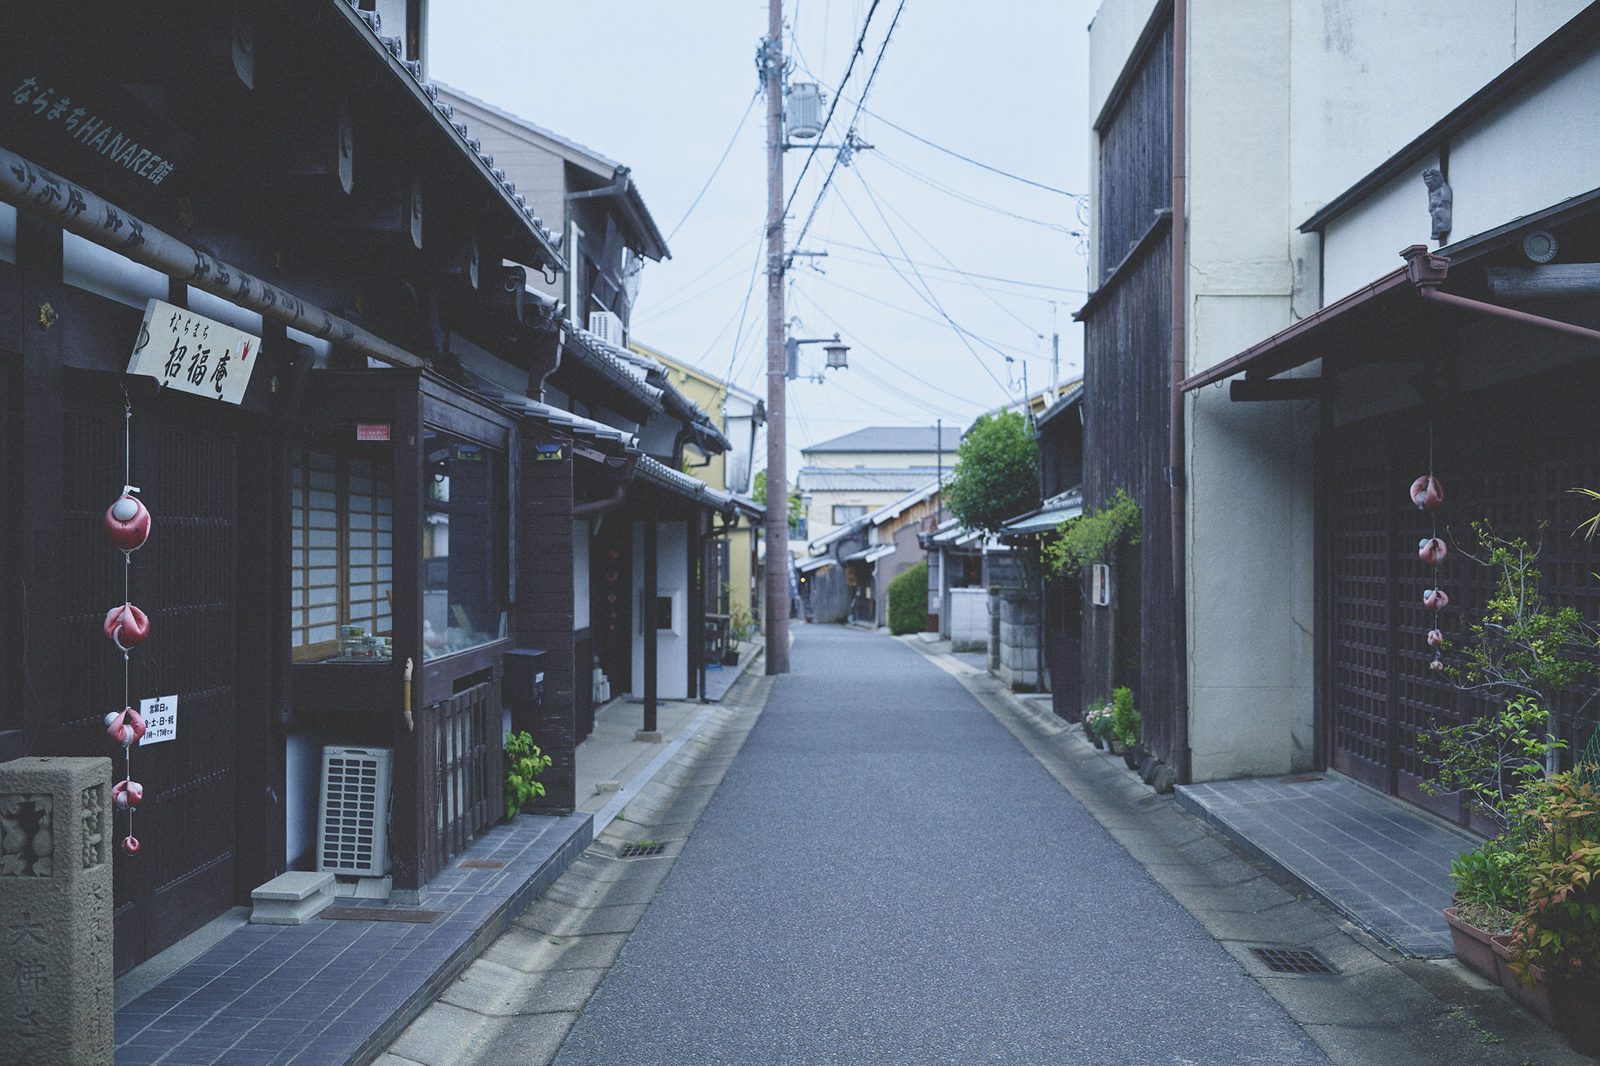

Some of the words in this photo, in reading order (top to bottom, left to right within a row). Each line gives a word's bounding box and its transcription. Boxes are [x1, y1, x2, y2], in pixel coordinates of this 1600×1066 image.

[169, 312, 210, 340] ならまち
[164, 336, 231, 393] 招福庵
